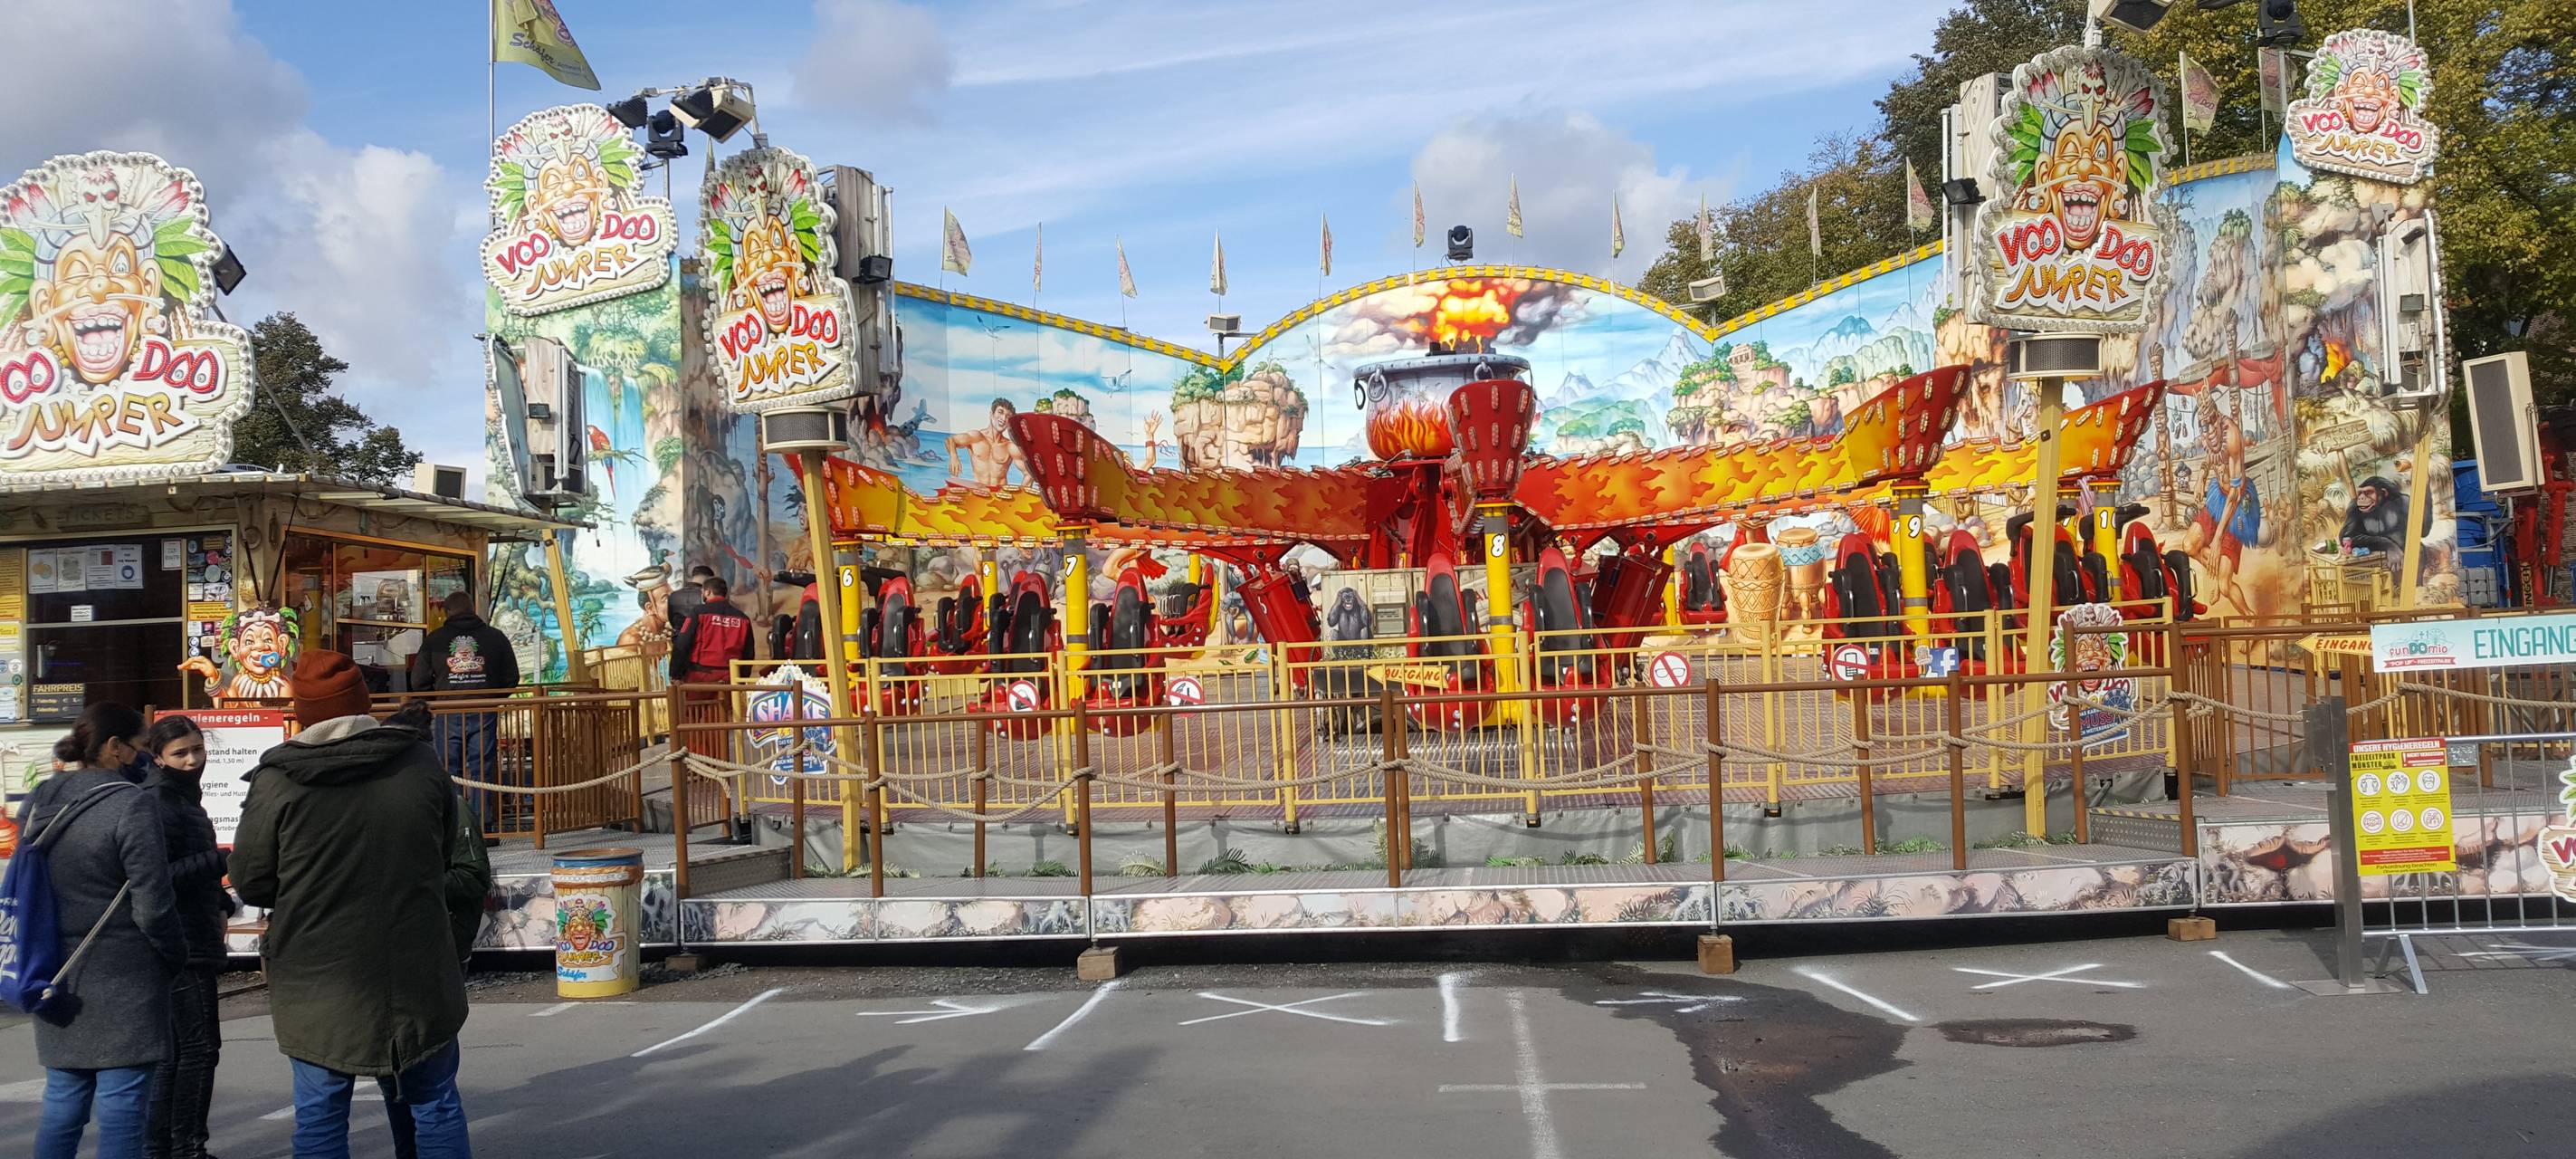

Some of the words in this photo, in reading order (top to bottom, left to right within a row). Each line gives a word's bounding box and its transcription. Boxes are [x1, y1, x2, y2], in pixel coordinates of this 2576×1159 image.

[2302, 112, 2343, 132] VOO
[2380, 120, 2422, 149] DOO
[2315, 133, 2401, 160] JUMPER
[495, 233, 550, 274] VOO
[600, 214, 655, 240] DOO
[1998, 217, 2061, 267] VOO
[2094, 226, 2153, 276] DOO
[526, 244, 637, 295] JUMPER
[2005, 263, 2129, 303] JUMPER
[720, 312, 762, 360] VOO
[791, 304, 837, 342] DOO
[0, 350, 54, 404] OO
[132, 340, 220, 394] DOO
[738, 340, 826, 392] JUMPER
[7, 391, 185, 450] JUMPER
[1908, 515, 1921, 539] 9
[1491, 533, 1506, 558] 8
[842, 569, 854, 587] 6
[983, 563, 991, 577] 4
[1065, 555, 1078, 577] 7
[33, 683, 84, 693] FAHRPREIS
[189, 713, 261, 724] gieneregeln
[205, 747, 230, 756] stand
[232, 747, 258, 756] halten
[2351, 752, 2396, 761] FREIZEITPARK
[2353, 742, 2382, 753] UNSERE
[201, 781, 229, 790] ygiene
[588, 940, 615, 951] DOO
